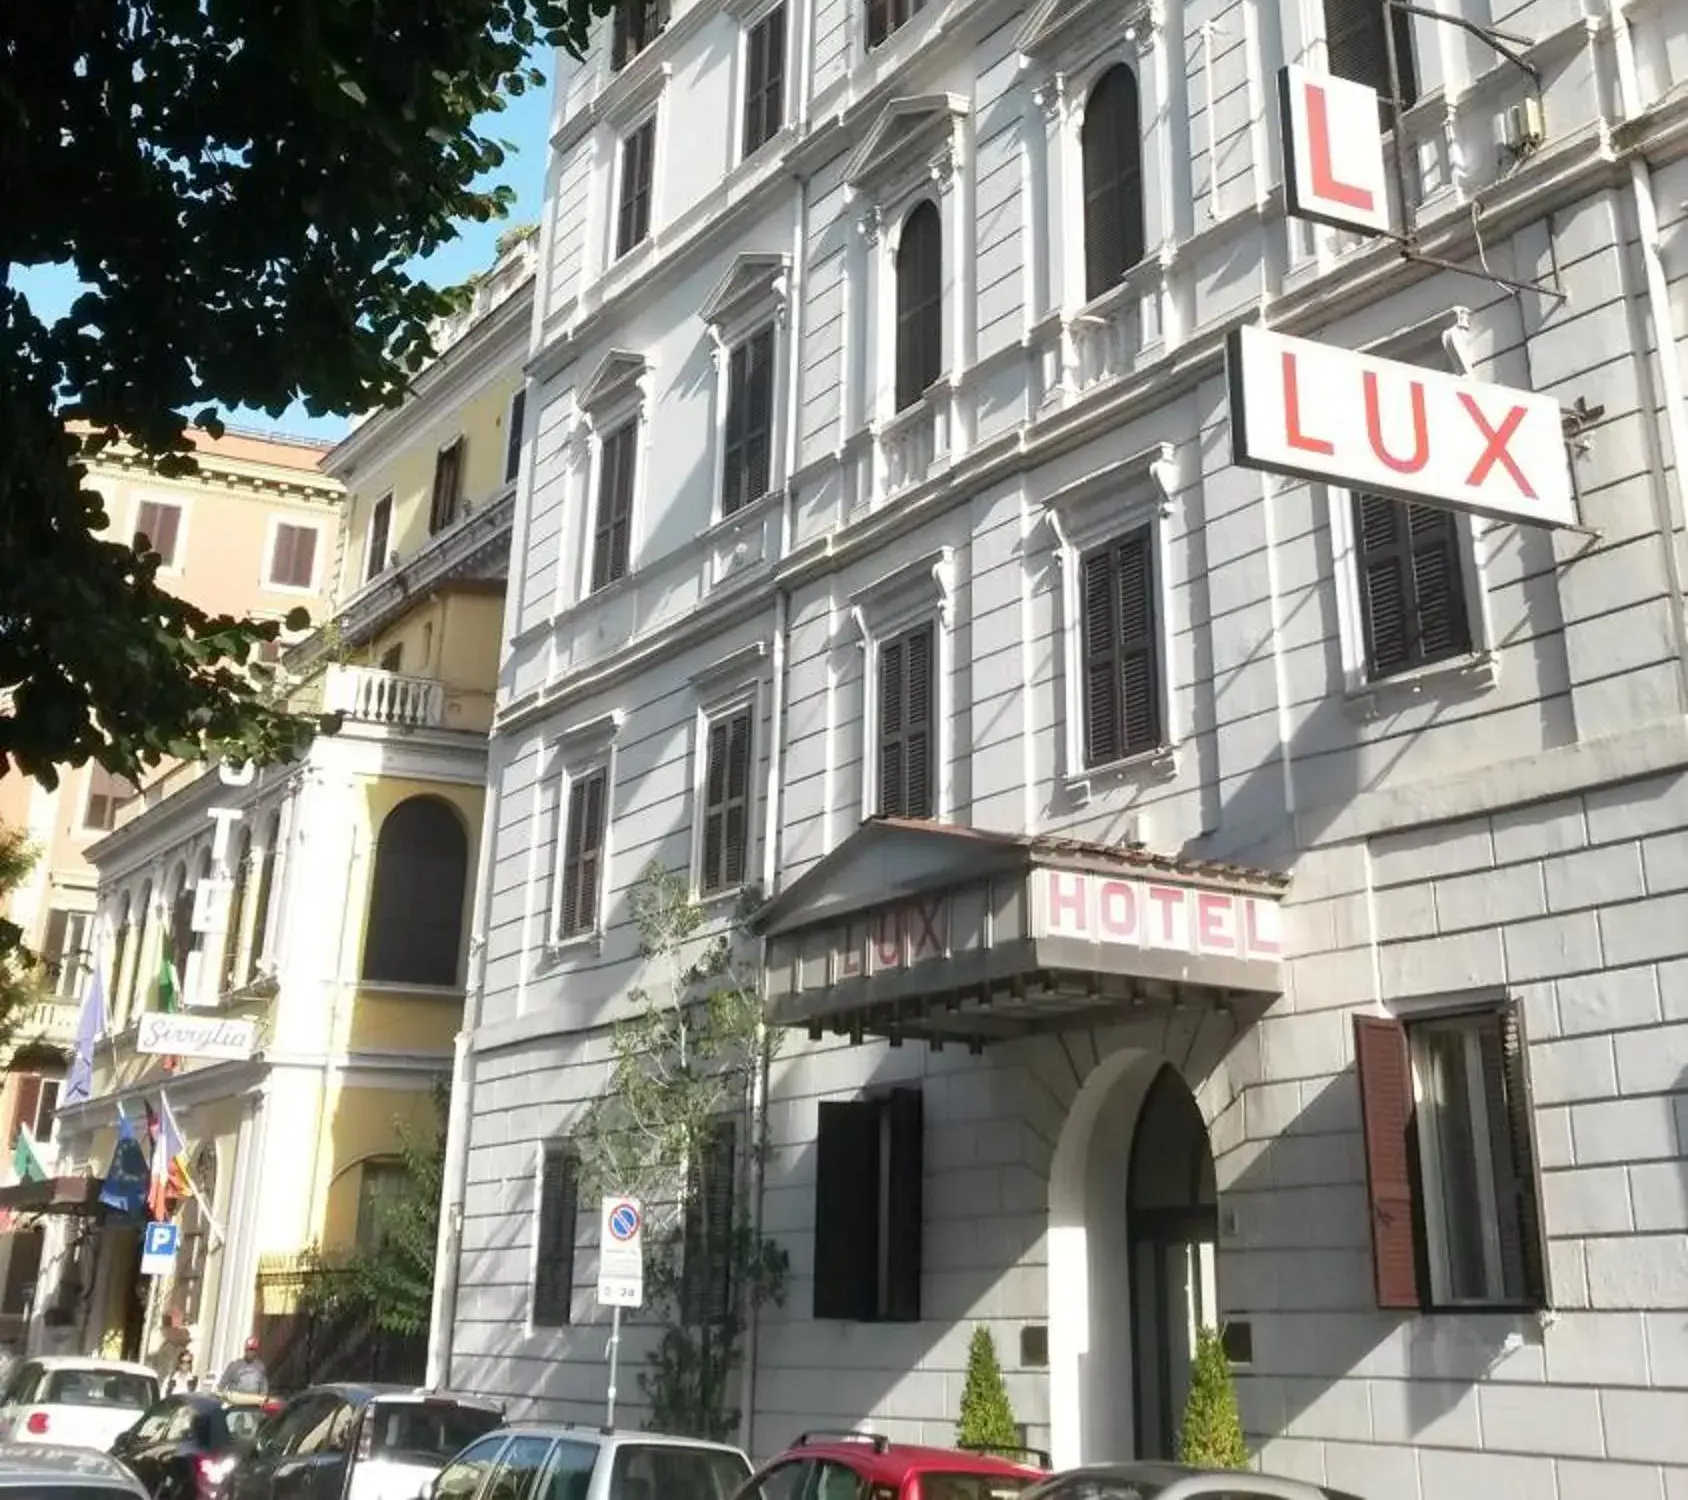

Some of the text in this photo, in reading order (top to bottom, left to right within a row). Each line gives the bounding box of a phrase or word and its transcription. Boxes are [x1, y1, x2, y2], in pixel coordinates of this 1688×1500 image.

[1281, 351, 1540, 500] LUX
[842, 897, 943, 975] LUX
[1049, 873, 1282, 954] HOTEL
[151, 1227, 171, 1252] P
